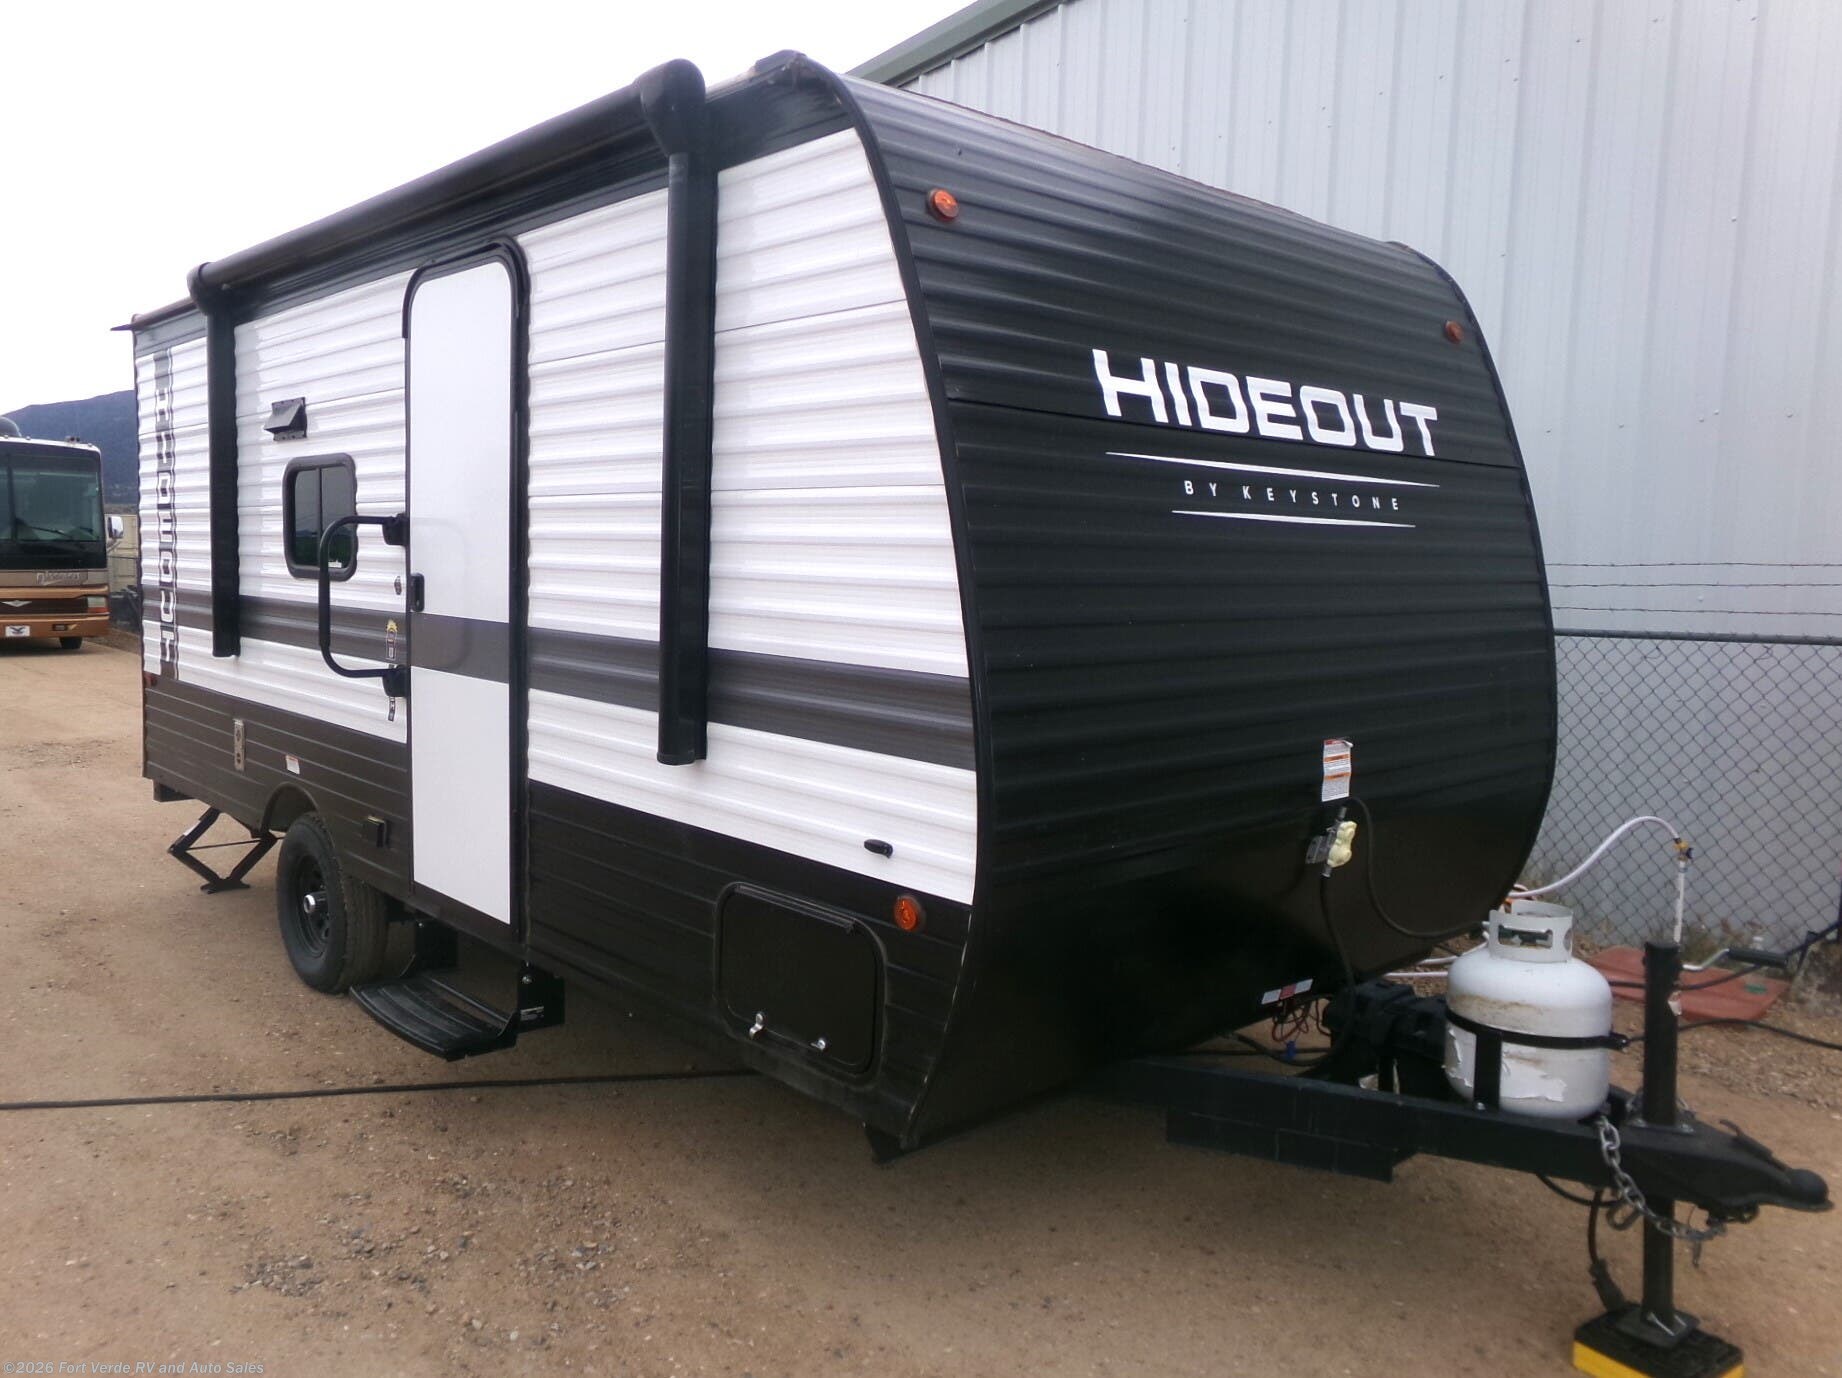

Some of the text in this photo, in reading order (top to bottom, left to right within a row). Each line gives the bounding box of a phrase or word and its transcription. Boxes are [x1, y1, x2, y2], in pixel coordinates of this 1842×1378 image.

[1091, 348, 1439, 457] HIDEOUT
[155, 387, 175, 662] HIDEOUT
[1184, 479, 1400, 511] BY KEYSTONE
